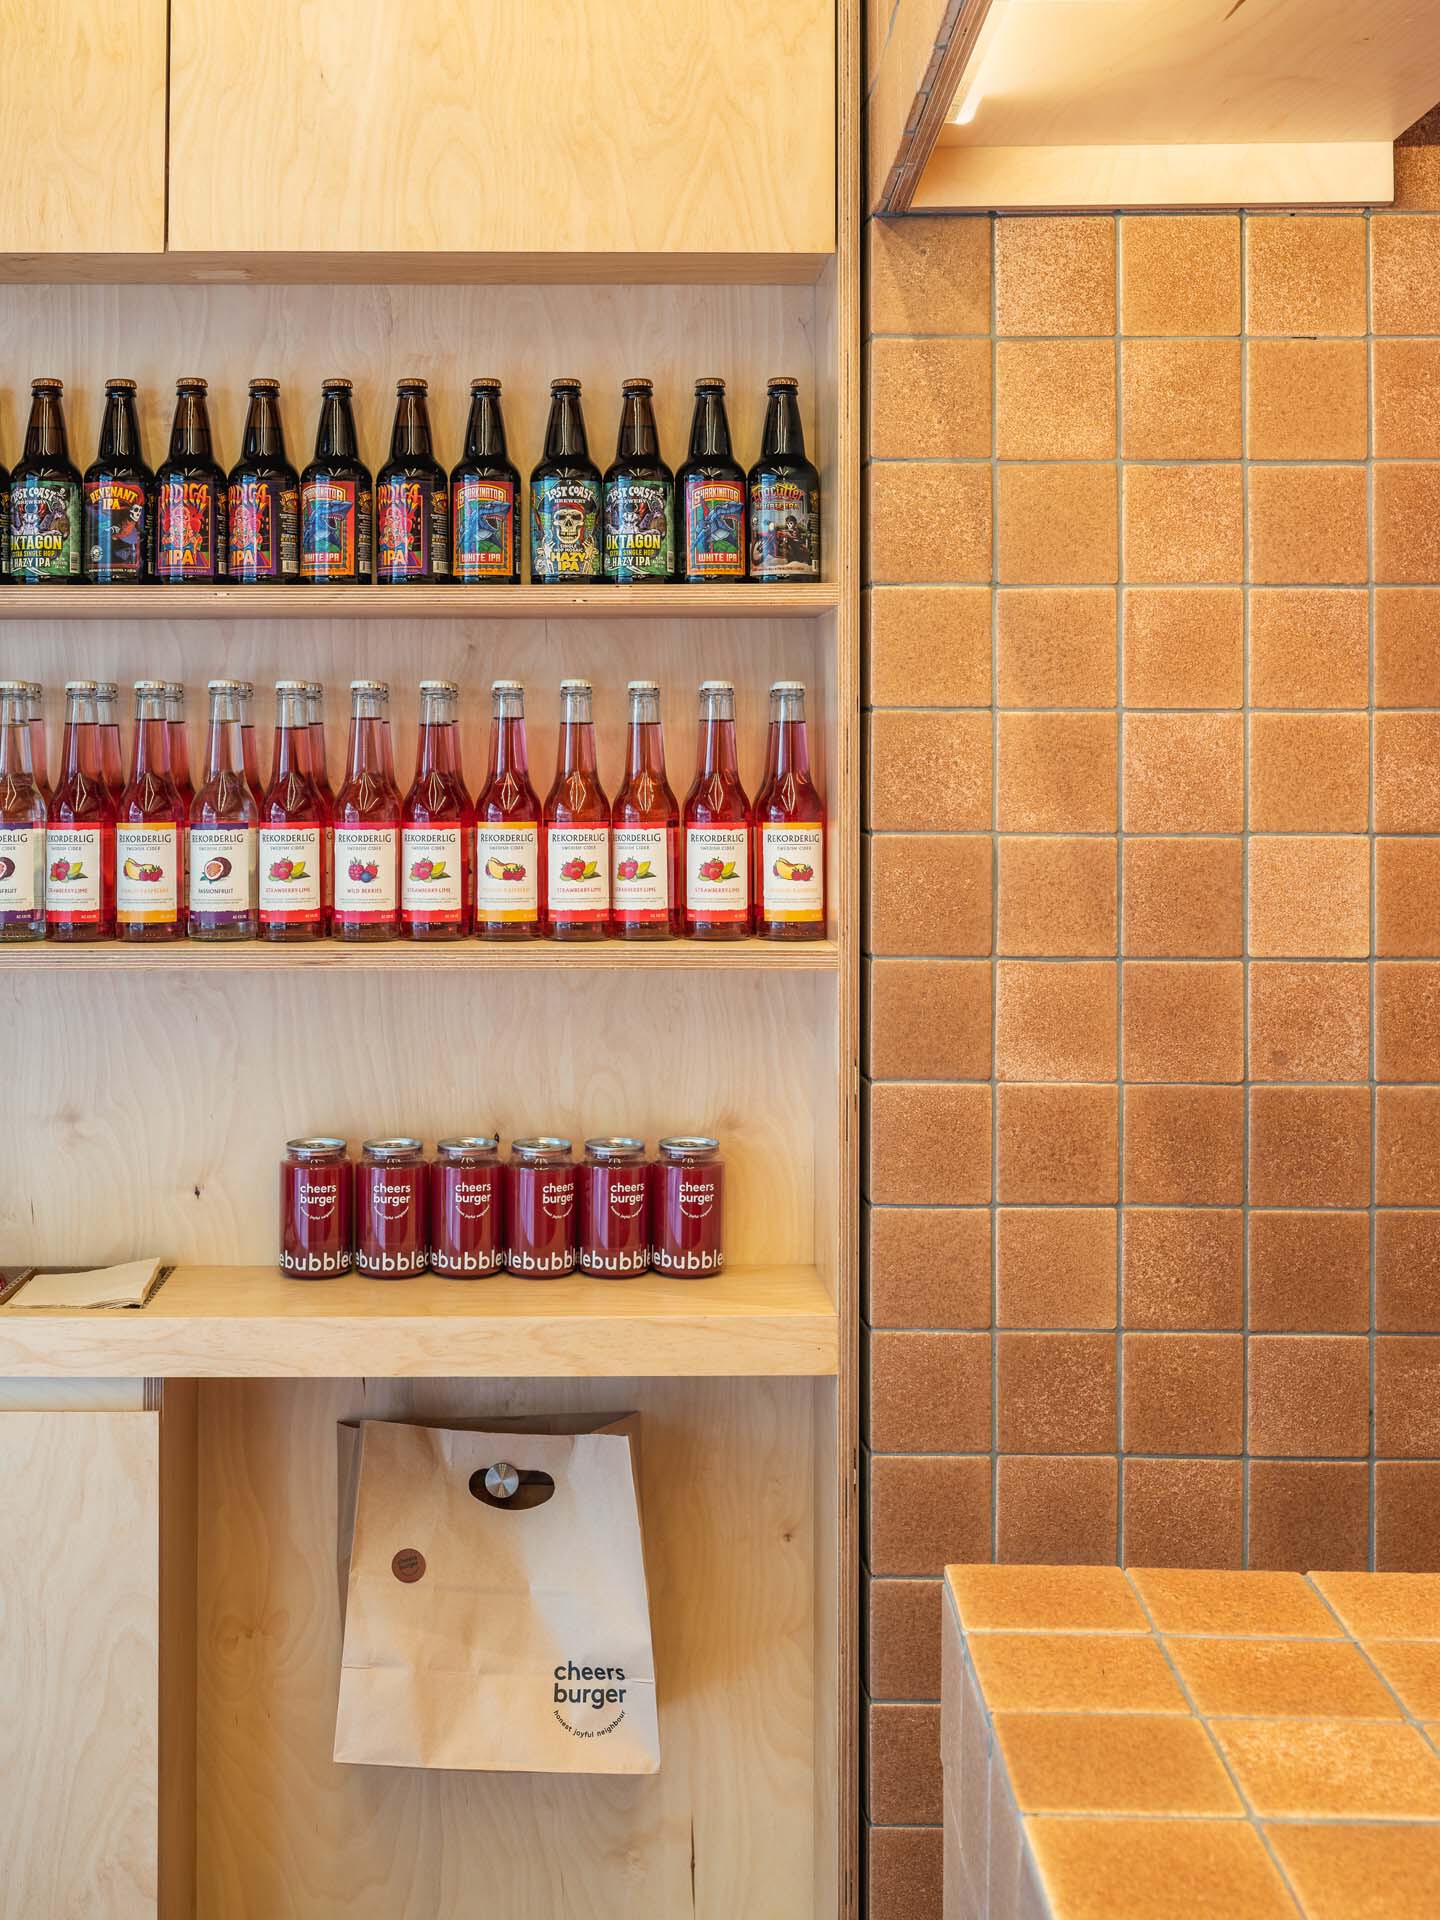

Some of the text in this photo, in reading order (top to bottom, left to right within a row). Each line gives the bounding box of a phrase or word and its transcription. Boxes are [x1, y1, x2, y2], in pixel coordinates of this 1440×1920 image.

[28, 487, 57, 501] COAST
[89, 485, 138, 504] REVENANT
[458, 486, 504, 504] SHARKINATOR
[545, 485, 594, 502] LOST COAST
[628, 486, 656, 501] COAST
[693, 486, 739, 504] SHARKINATOR
[103, 498, 121, 510] IPA
[606, 534, 661, 550] OKTAGON
[14, 557, 33, 567] HAZY
[35, 557, 51, 567] IPA
[167, 549, 195, 565] IPA
[232, 551, 256, 566] IPA
[383, 550, 406, 566] IPA
[461, 552, 501, 563] WHITE IPA
[550, 551, 586, 562] HAZY
[612, 557, 633, 567] HAZY
[635, 557, 651, 566] IPA
[698, 552, 737, 563] WHITE IPA
[557, 560, 580, 572] IPA
[47, 834, 94, 843] EKORDERLIG
[119, 834, 172, 843] REKORDERLIG
[191, 833, 244, 843] REKORDERLIG
[262, 833, 315, 842] REKORDERLIG
[338, 833, 392, 843] REKORDERLIG
[404, 833, 456, 843] REKORDERLIG
[480, 833, 534, 842] REKORDERLIG
[552, 833, 605, 842] REKORDERLIG
[615, 833, 661, 842] EKORDERLIG
[690, 833, 744, 843] REKORDERLIG
[767, 833, 820, 843] REKORDERLIG
[300, 1183, 337, 1193] cheers
[373, 1183, 411, 1193] cheers
[455, 1181, 491, 1192] cheers
[542, 1182, 574, 1193] cheers
[610, 1182, 645, 1193] cheers
[679, 1181, 714, 1192] cheers
[300, 1193, 337, 1207] burger
[373, 1192, 411, 1207] burger
[455, 1192, 491, 1206] burger
[542, 1193, 574, 1206] burger
[610, 1192, 645, 1206] burger
[679, 1192, 714, 1206] burger
[554, 1660, 625, 1681] cheers
[554, 1682, 627, 1710] burger
[553, 1709, 626, 1739] honest joyful neighbour
